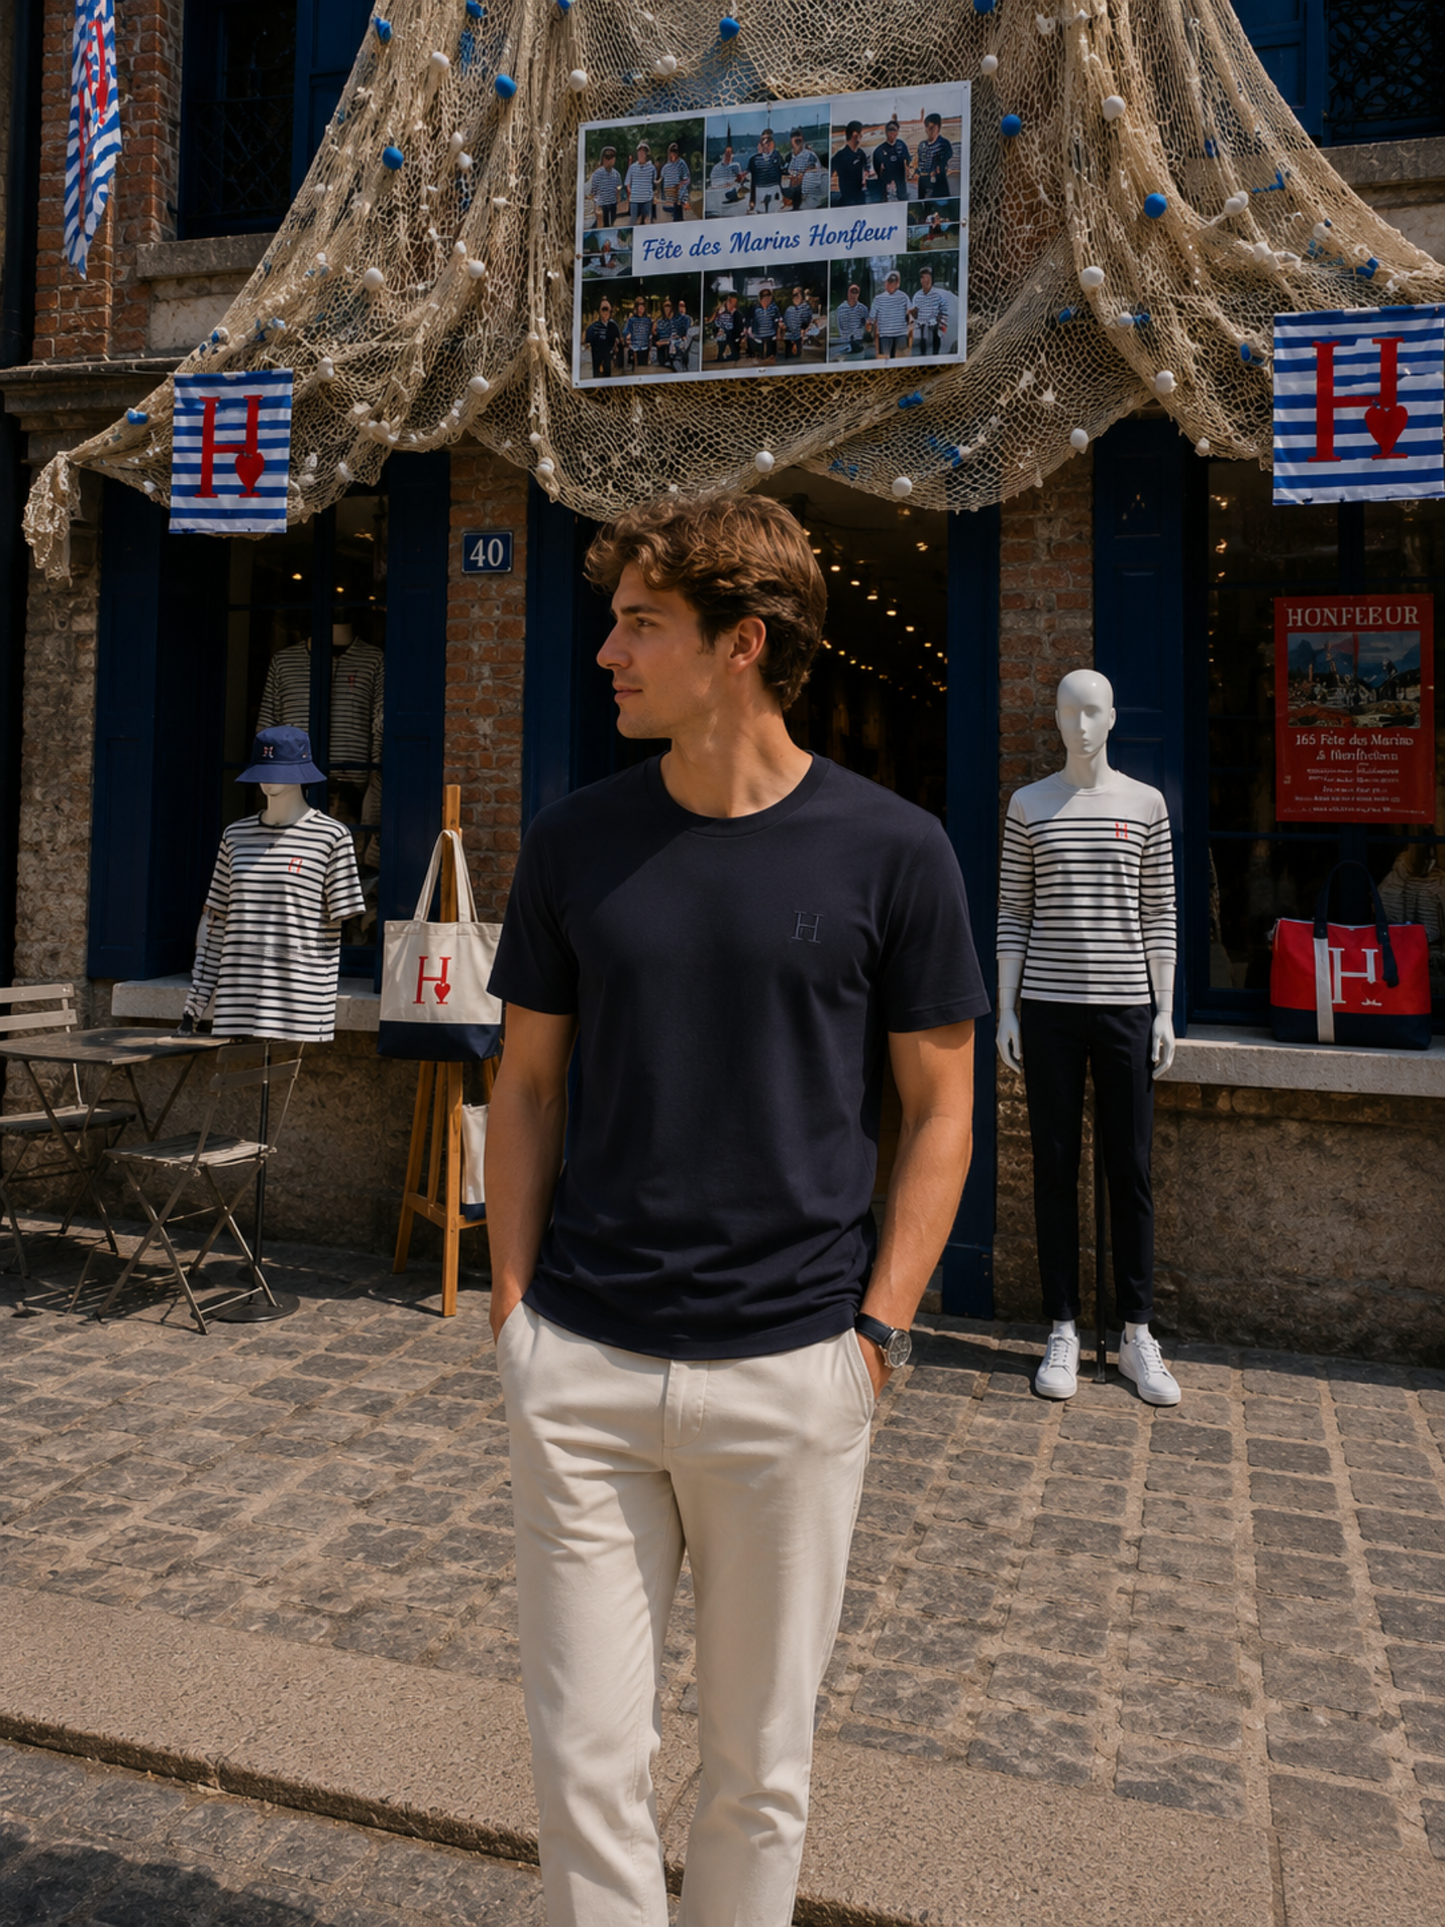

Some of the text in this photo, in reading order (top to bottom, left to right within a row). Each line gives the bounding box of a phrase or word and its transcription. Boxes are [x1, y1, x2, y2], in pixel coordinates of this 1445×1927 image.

[642, 219, 899, 261] Fête des Marins Honfleur
[1307, 337, 1408, 463] H
[194, 394, 265, 498] H
[469, 538, 504, 567] 40
[790, 910, 824, 944] H
[412, 955, 452, 1005] H
